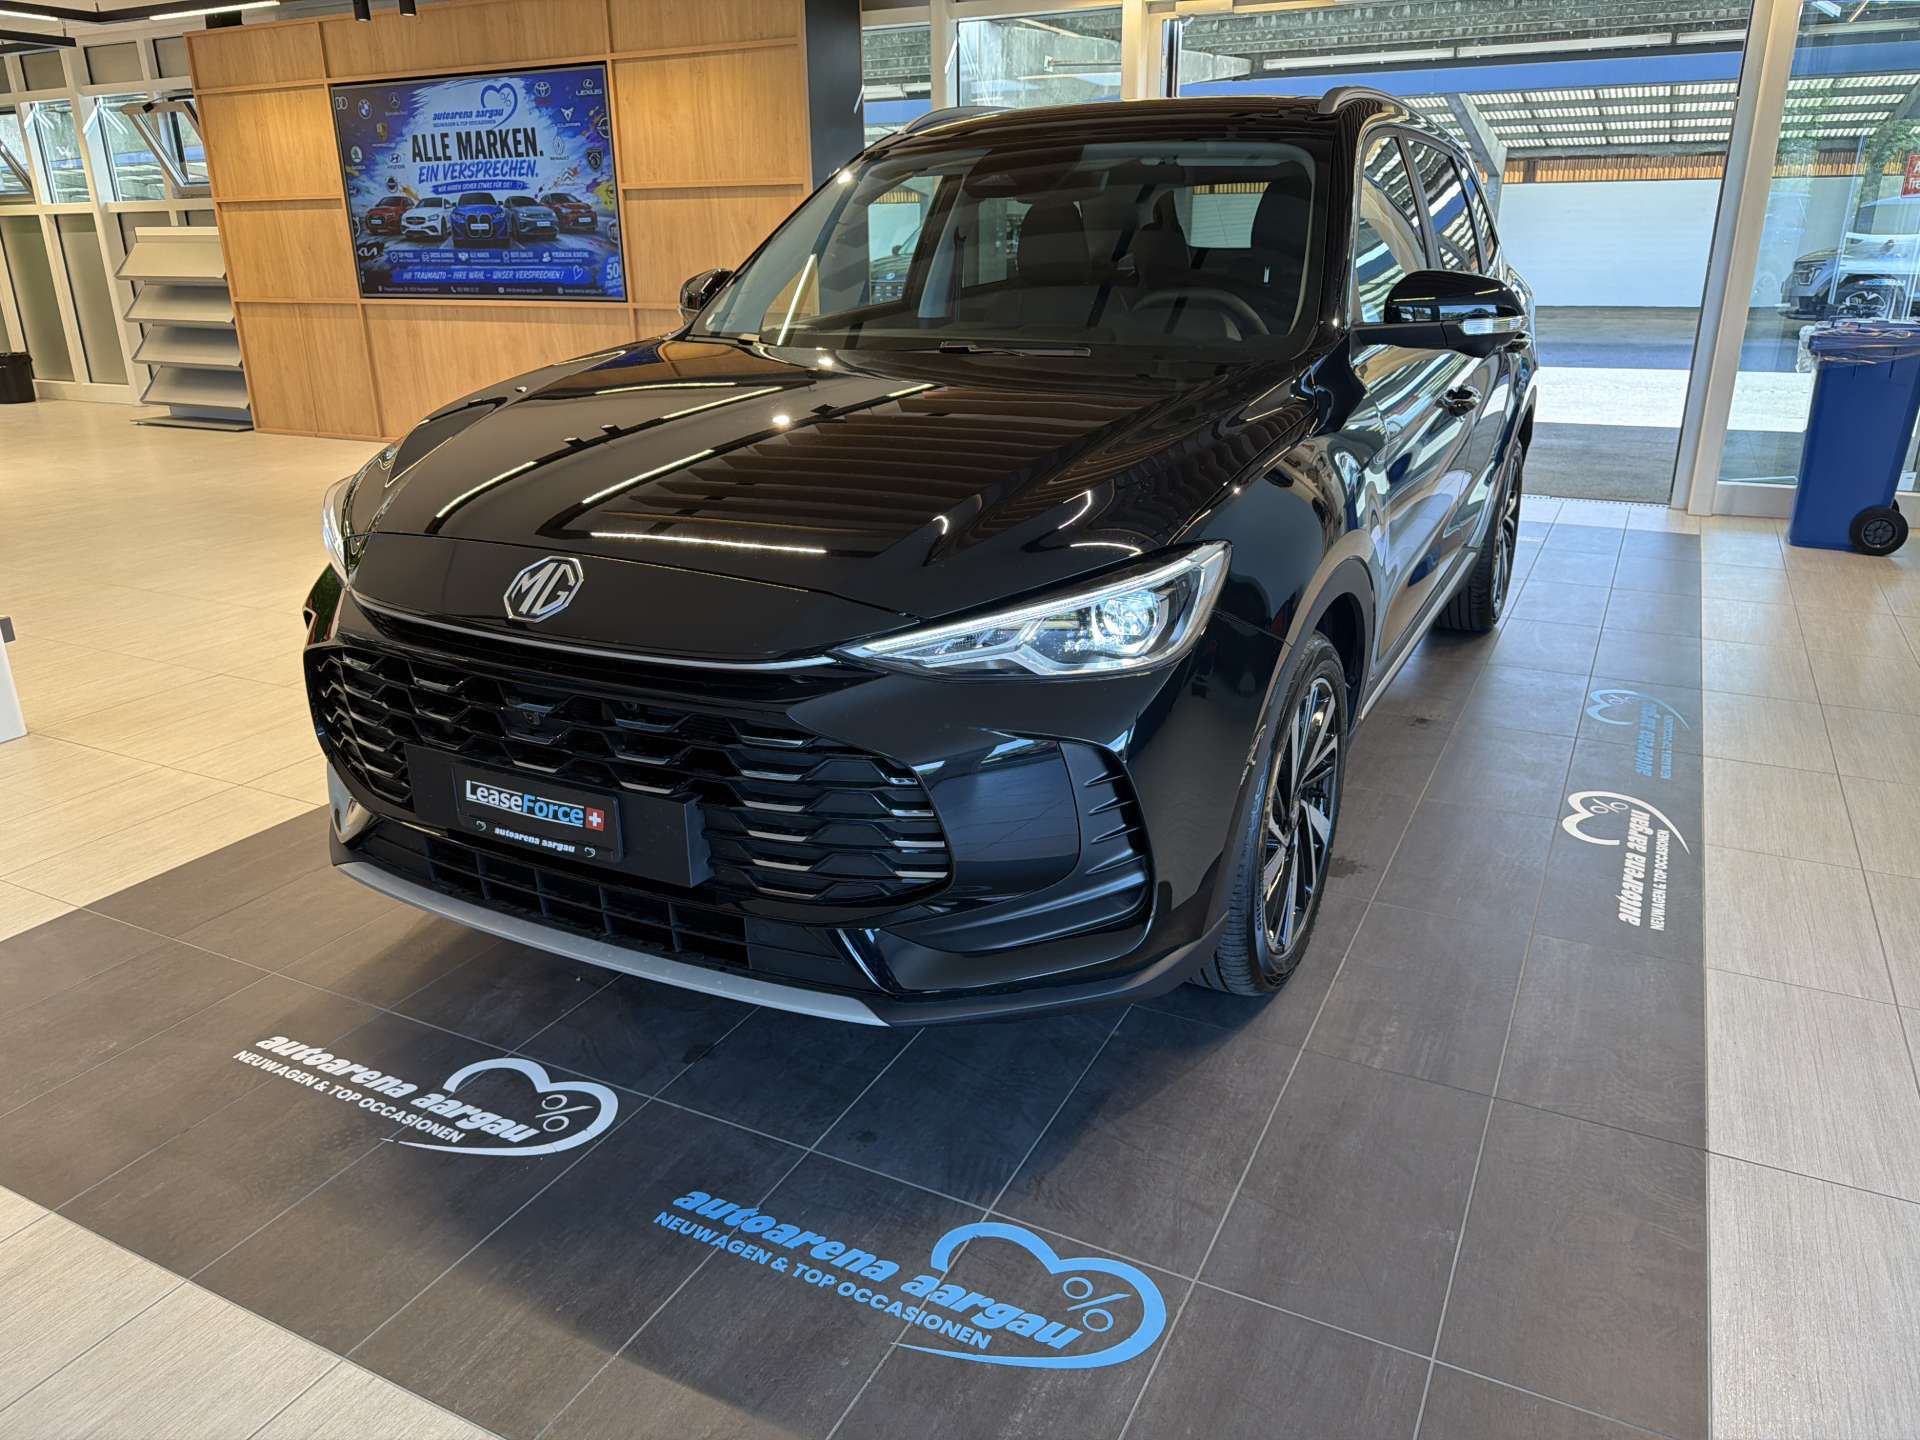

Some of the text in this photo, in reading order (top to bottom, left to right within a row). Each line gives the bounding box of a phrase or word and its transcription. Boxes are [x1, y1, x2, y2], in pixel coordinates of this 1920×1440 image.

[432, 111, 473, 121] autoarena
[412, 127, 544, 163] ALLE MARKEN.
[418, 160, 538, 184] EIN VERSPRECHEN.
[414, 272, 446, 280] TRAUMAUTO
[492, 271, 514, 280] UNSER
[515, 270, 564, 280] VERSPRECHEN!
[511, 562, 575, 615] MG
[466, 779, 584, 825] LeaseForce
[494, 827, 576, 854] autoarena aargau
[1655, 829, 1670, 868] OCCASIONEN
[1616, 809, 1654, 927] autoarena aargau
[1653, 868, 1667, 883] TOP
[1650, 889, 1666, 931] NEUWAGEN
[233, 1050, 316, 1089] NEUWAGEN
[330, 1084, 361, 1103] TOP
[359, 1096, 466, 1144] OCCASIONEN
[255, 1035, 540, 1143] autoarena aargau
[654, 1211, 772, 1265] NEUWAGEN
[793, 1262, 838, 1288] TOP
[837, 1280, 992, 1351] OCCASIONEN
[673, 1190, 1084, 1351] autoarena aargau
